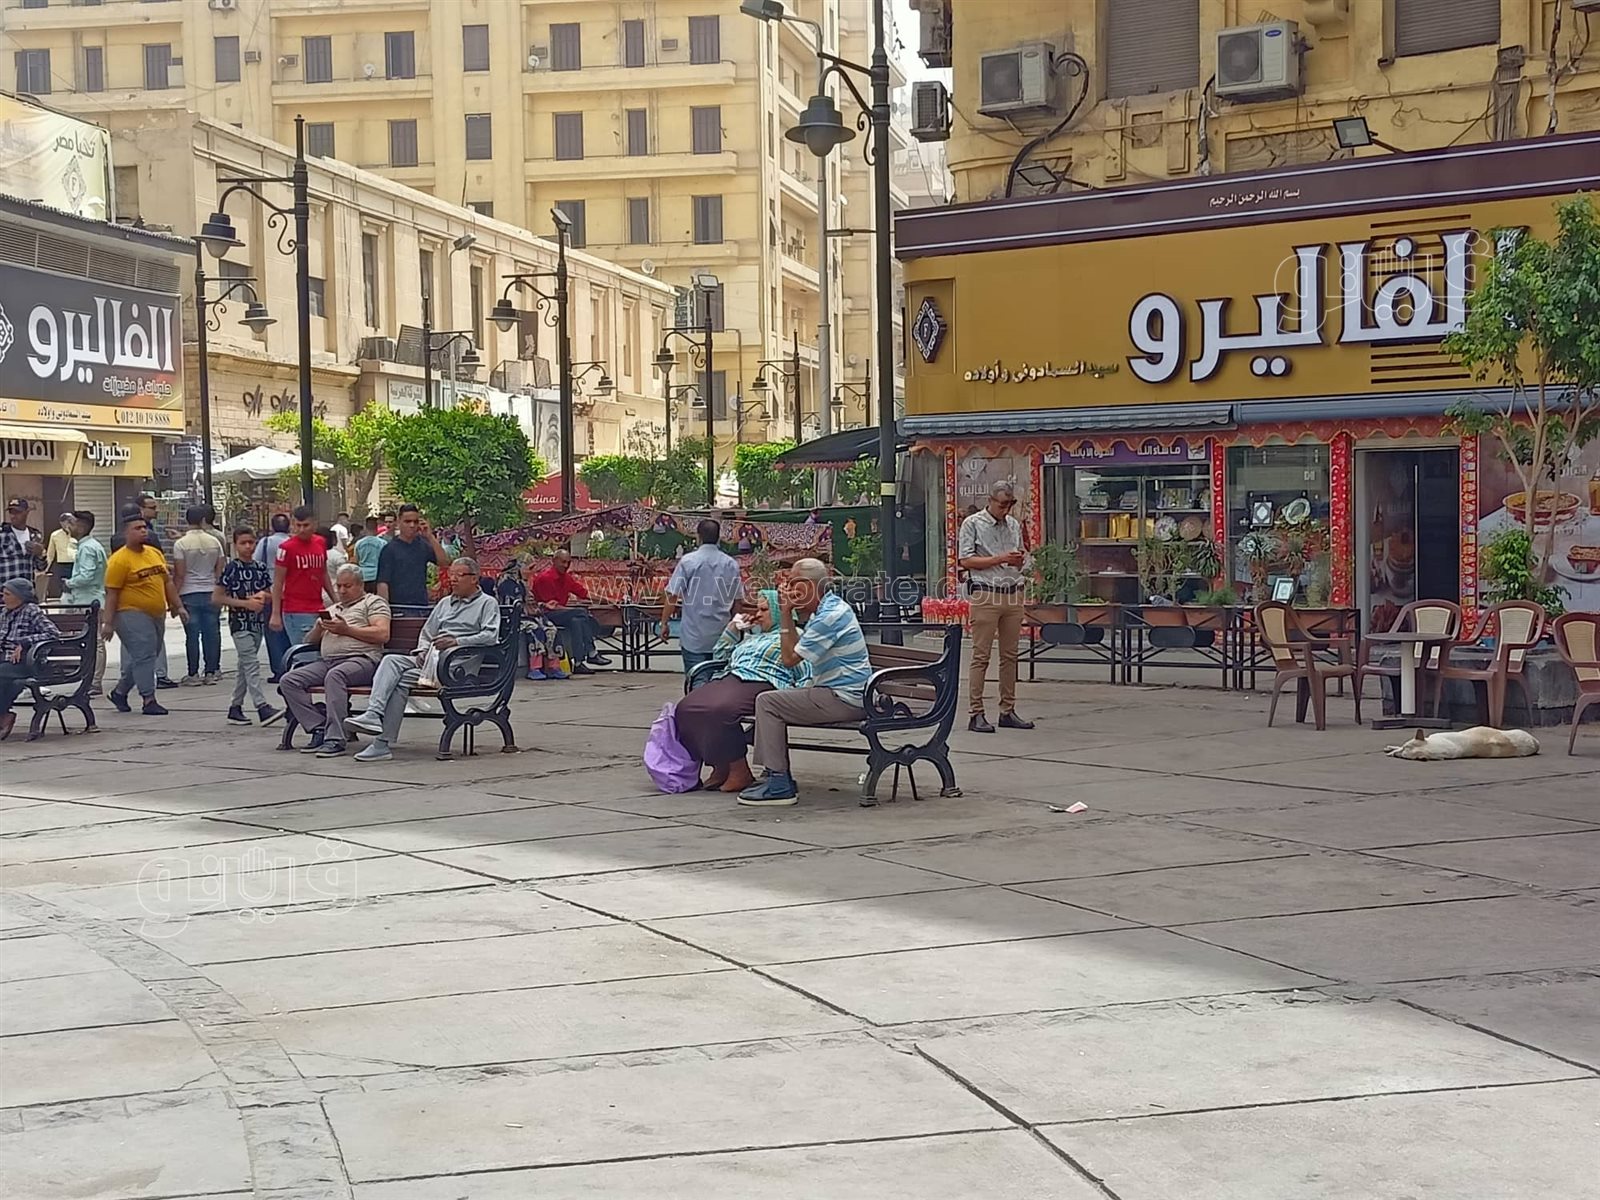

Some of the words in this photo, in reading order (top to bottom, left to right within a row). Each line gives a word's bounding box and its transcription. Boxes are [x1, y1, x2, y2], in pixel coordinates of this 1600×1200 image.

[52, 134, 74, 153] مصر
[75, 130, 96, 158] تحيا
[1208, 192, 1237, 208] الرحيم
[1237, 189, 1268, 205] الرحمن
[1268, 188, 1283, 199] الله
[1283, 188, 1301, 200] بسم
[26, 296, 176, 385] الفاليرو
[86, 440, 131, 467] مخبوزات
